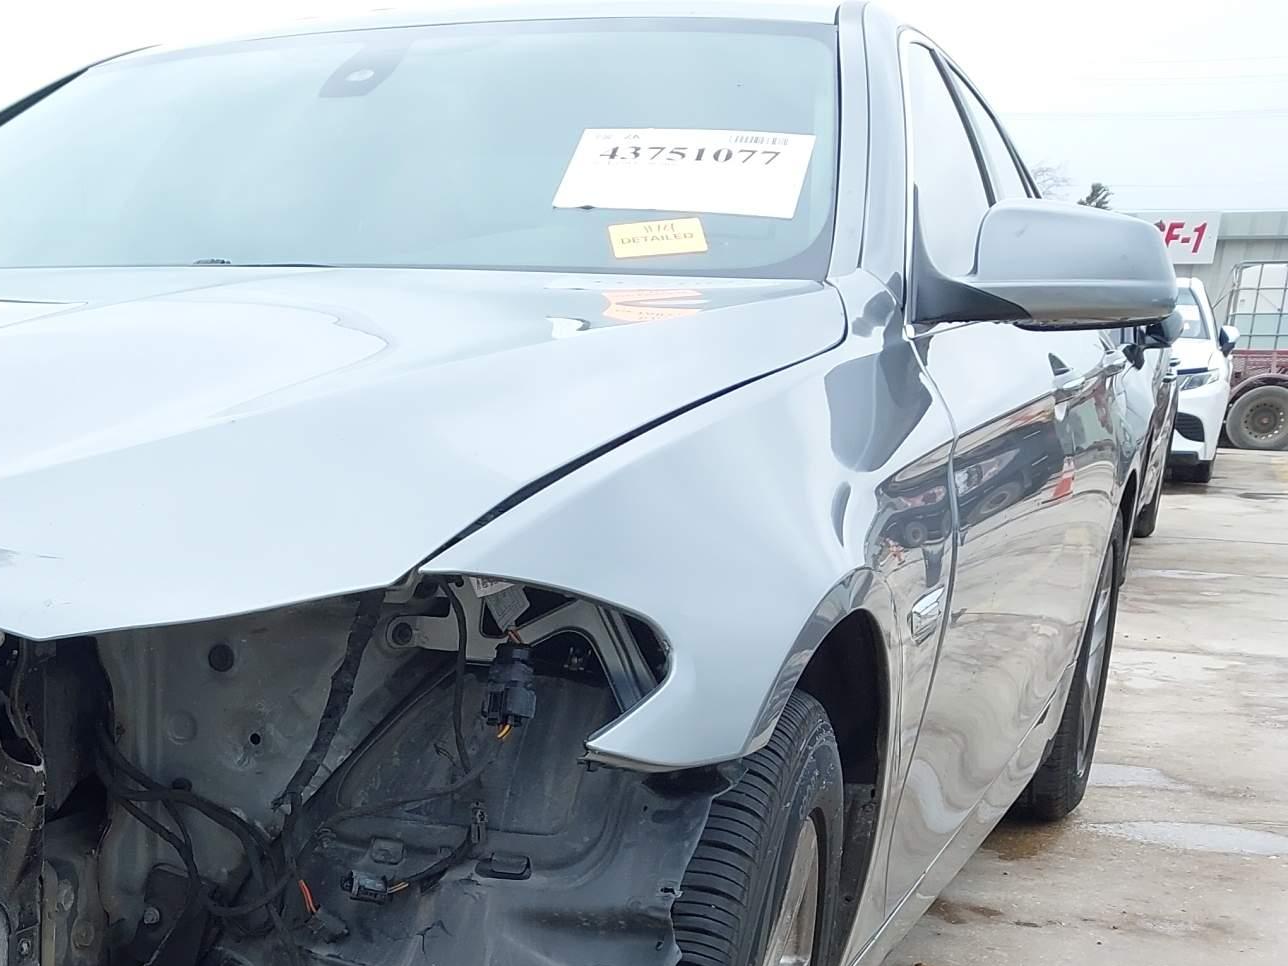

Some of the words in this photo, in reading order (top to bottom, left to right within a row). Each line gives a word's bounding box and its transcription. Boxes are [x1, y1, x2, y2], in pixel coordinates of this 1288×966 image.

[599, 145, 782, 166] 43751077
[620, 231, 695, 246] DETAILED
[1154, 219, 1208, 254] F-1
